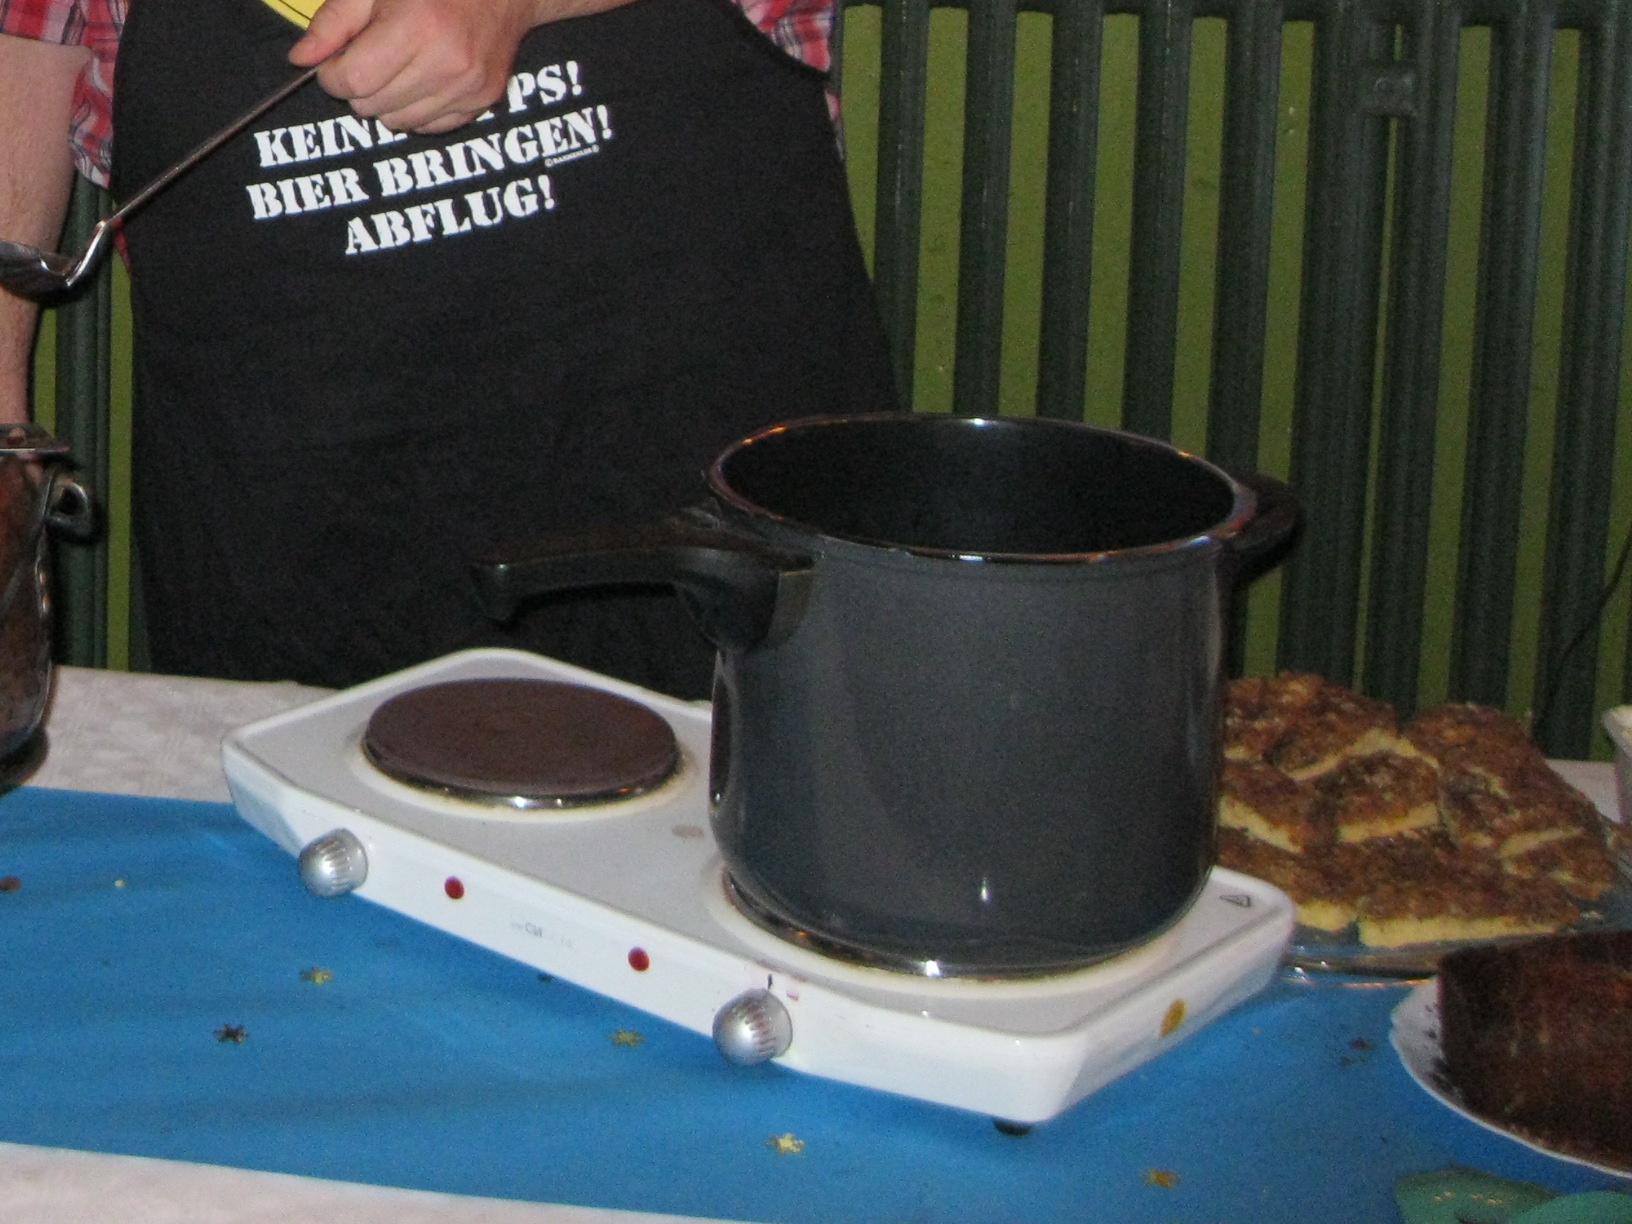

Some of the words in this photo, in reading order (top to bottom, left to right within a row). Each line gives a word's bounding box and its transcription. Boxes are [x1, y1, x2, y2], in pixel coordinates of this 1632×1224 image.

[245, 167, 370, 220] BIER
[372, 104, 613, 197] BRINGEN!
[345, 174, 555, 255] ABFLUG!
